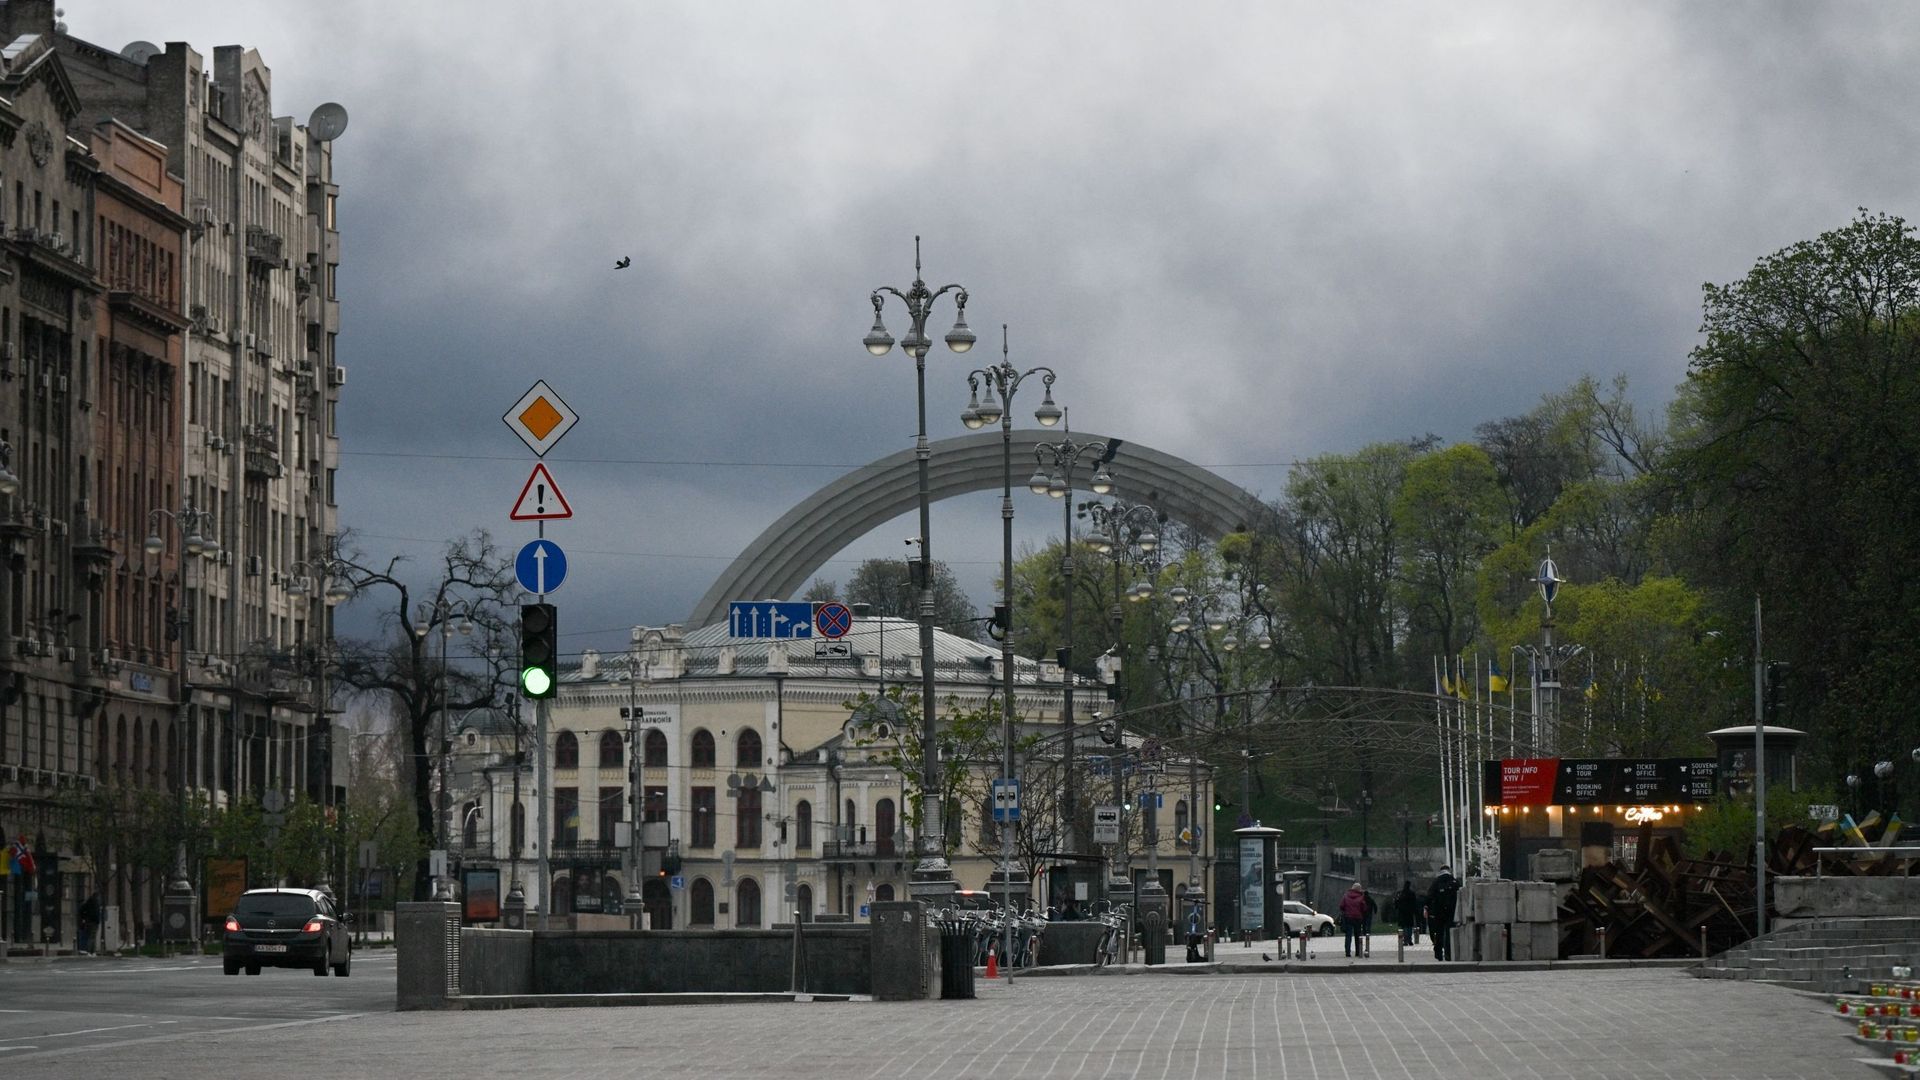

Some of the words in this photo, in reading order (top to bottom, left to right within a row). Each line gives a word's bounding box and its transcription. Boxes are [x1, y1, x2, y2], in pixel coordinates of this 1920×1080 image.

[1522, 766, 1538, 774] INFO
[1636, 789, 1648, 797] BAR
[1624, 807, 1663, 826] Coffee
